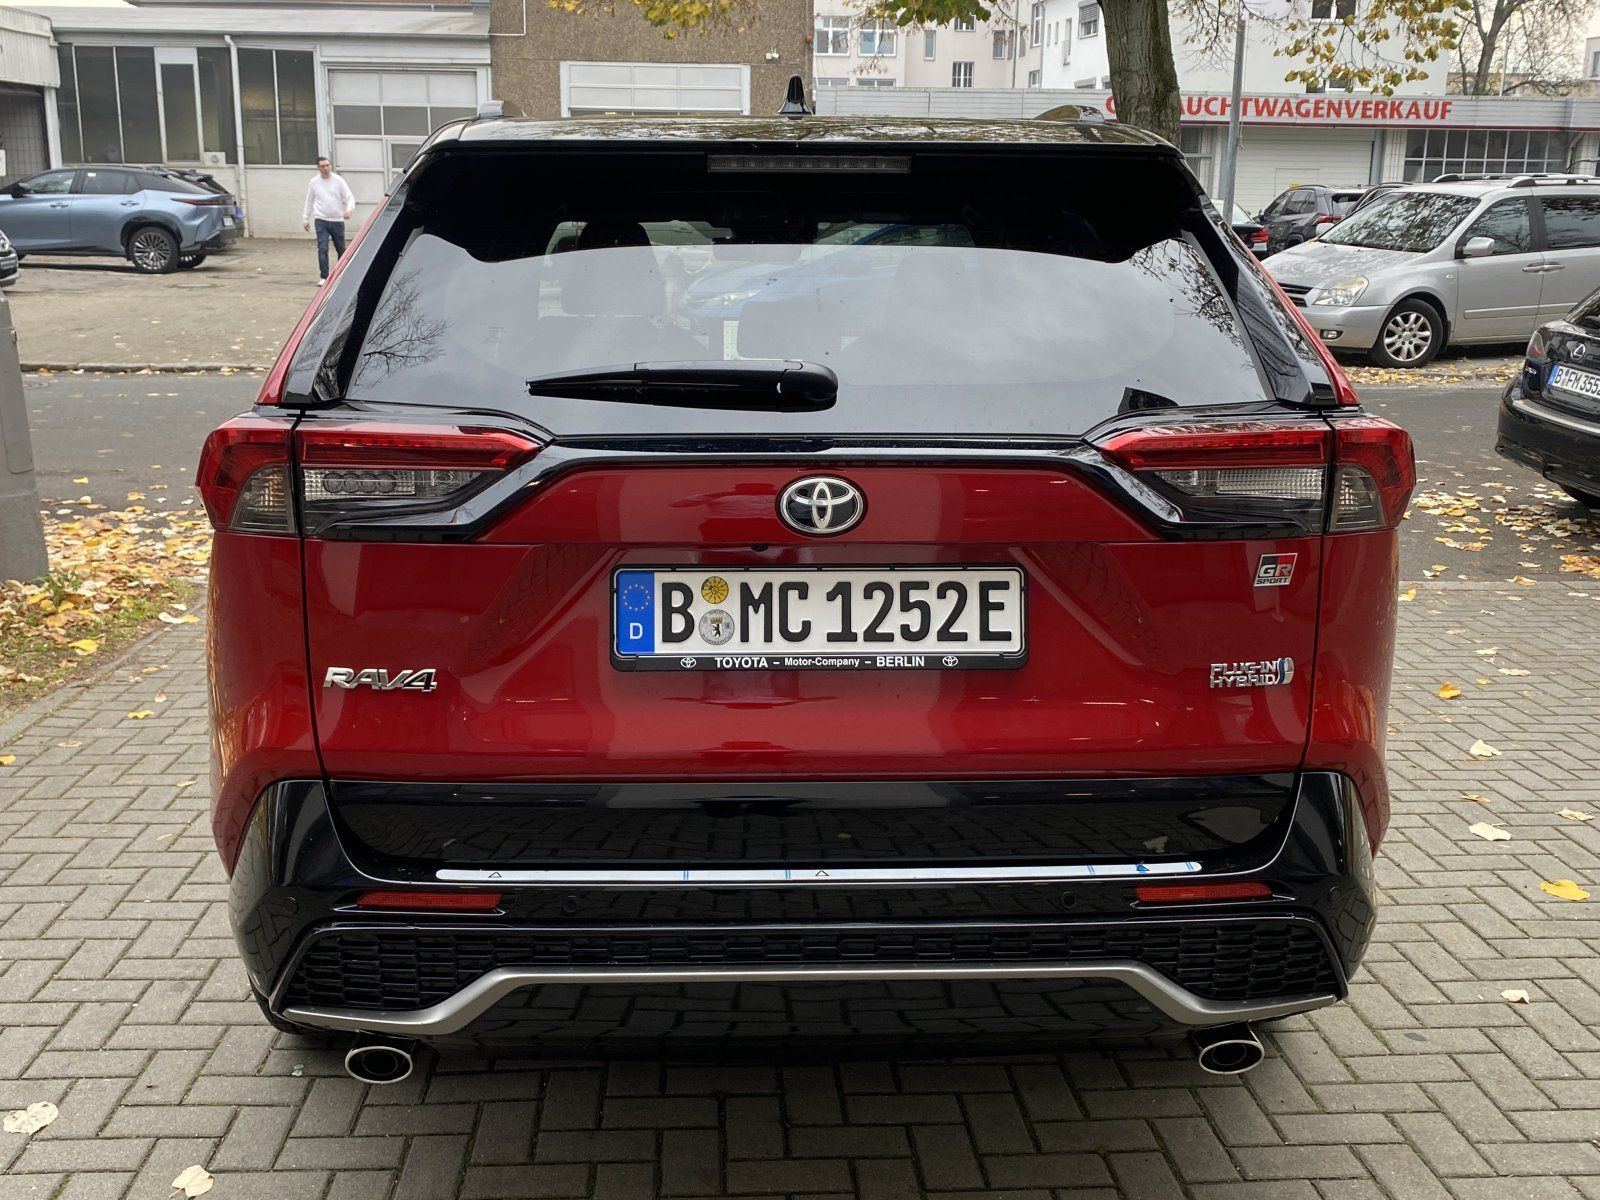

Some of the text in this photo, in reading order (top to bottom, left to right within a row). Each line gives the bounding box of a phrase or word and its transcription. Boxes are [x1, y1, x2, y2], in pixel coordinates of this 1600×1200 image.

[1554, 368, 1564, 384] B
[1579, 374, 1600, 396] 355
[1259, 563, 1293, 577] GR
[1255, 577, 1288, 585] SPORT
[661, 582, 695, 643] B
[739, 581, 812, 643] MC
[826, 581, 1012, 643] 1252E
[629, 622, 643, 640] D
[714, 656, 769, 668] TOYOTA
[784, 657, 860, 668] Motor-Company
[876, 656, 925, 667] BERLIN
[1210, 661, 1277, 676] PLUG-IN
[323, 667, 438, 692] RAV4
[1210, 674, 1276, 688] HYBRID
